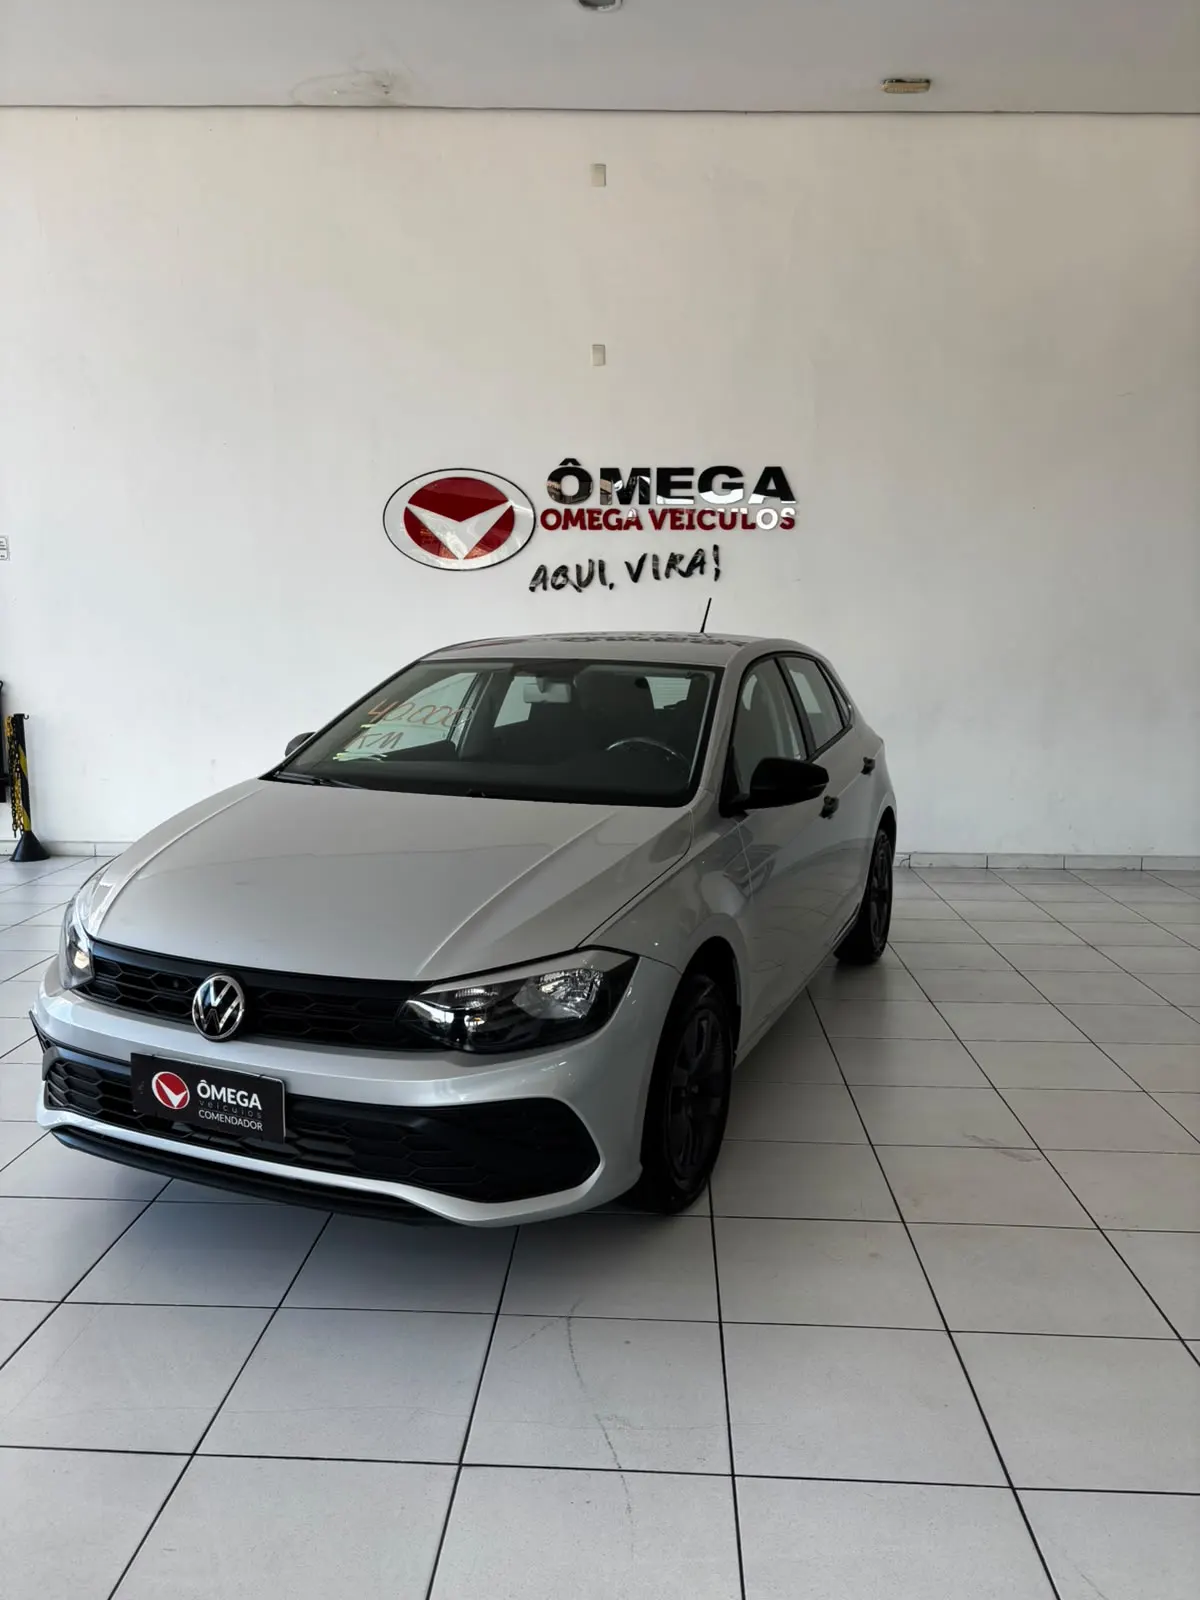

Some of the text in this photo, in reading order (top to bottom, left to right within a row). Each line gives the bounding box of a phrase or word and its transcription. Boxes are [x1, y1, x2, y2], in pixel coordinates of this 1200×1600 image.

[546, 457, 797, 506] ÔMEGA
[540, 507, 796, 531] OMEGA VEICULOS
[624, 544, 721, 583] VIRA!
[196, 1079, 262, 1111] ÔMEGA
[198, 1109, 264, 1132] COMENDADOR
